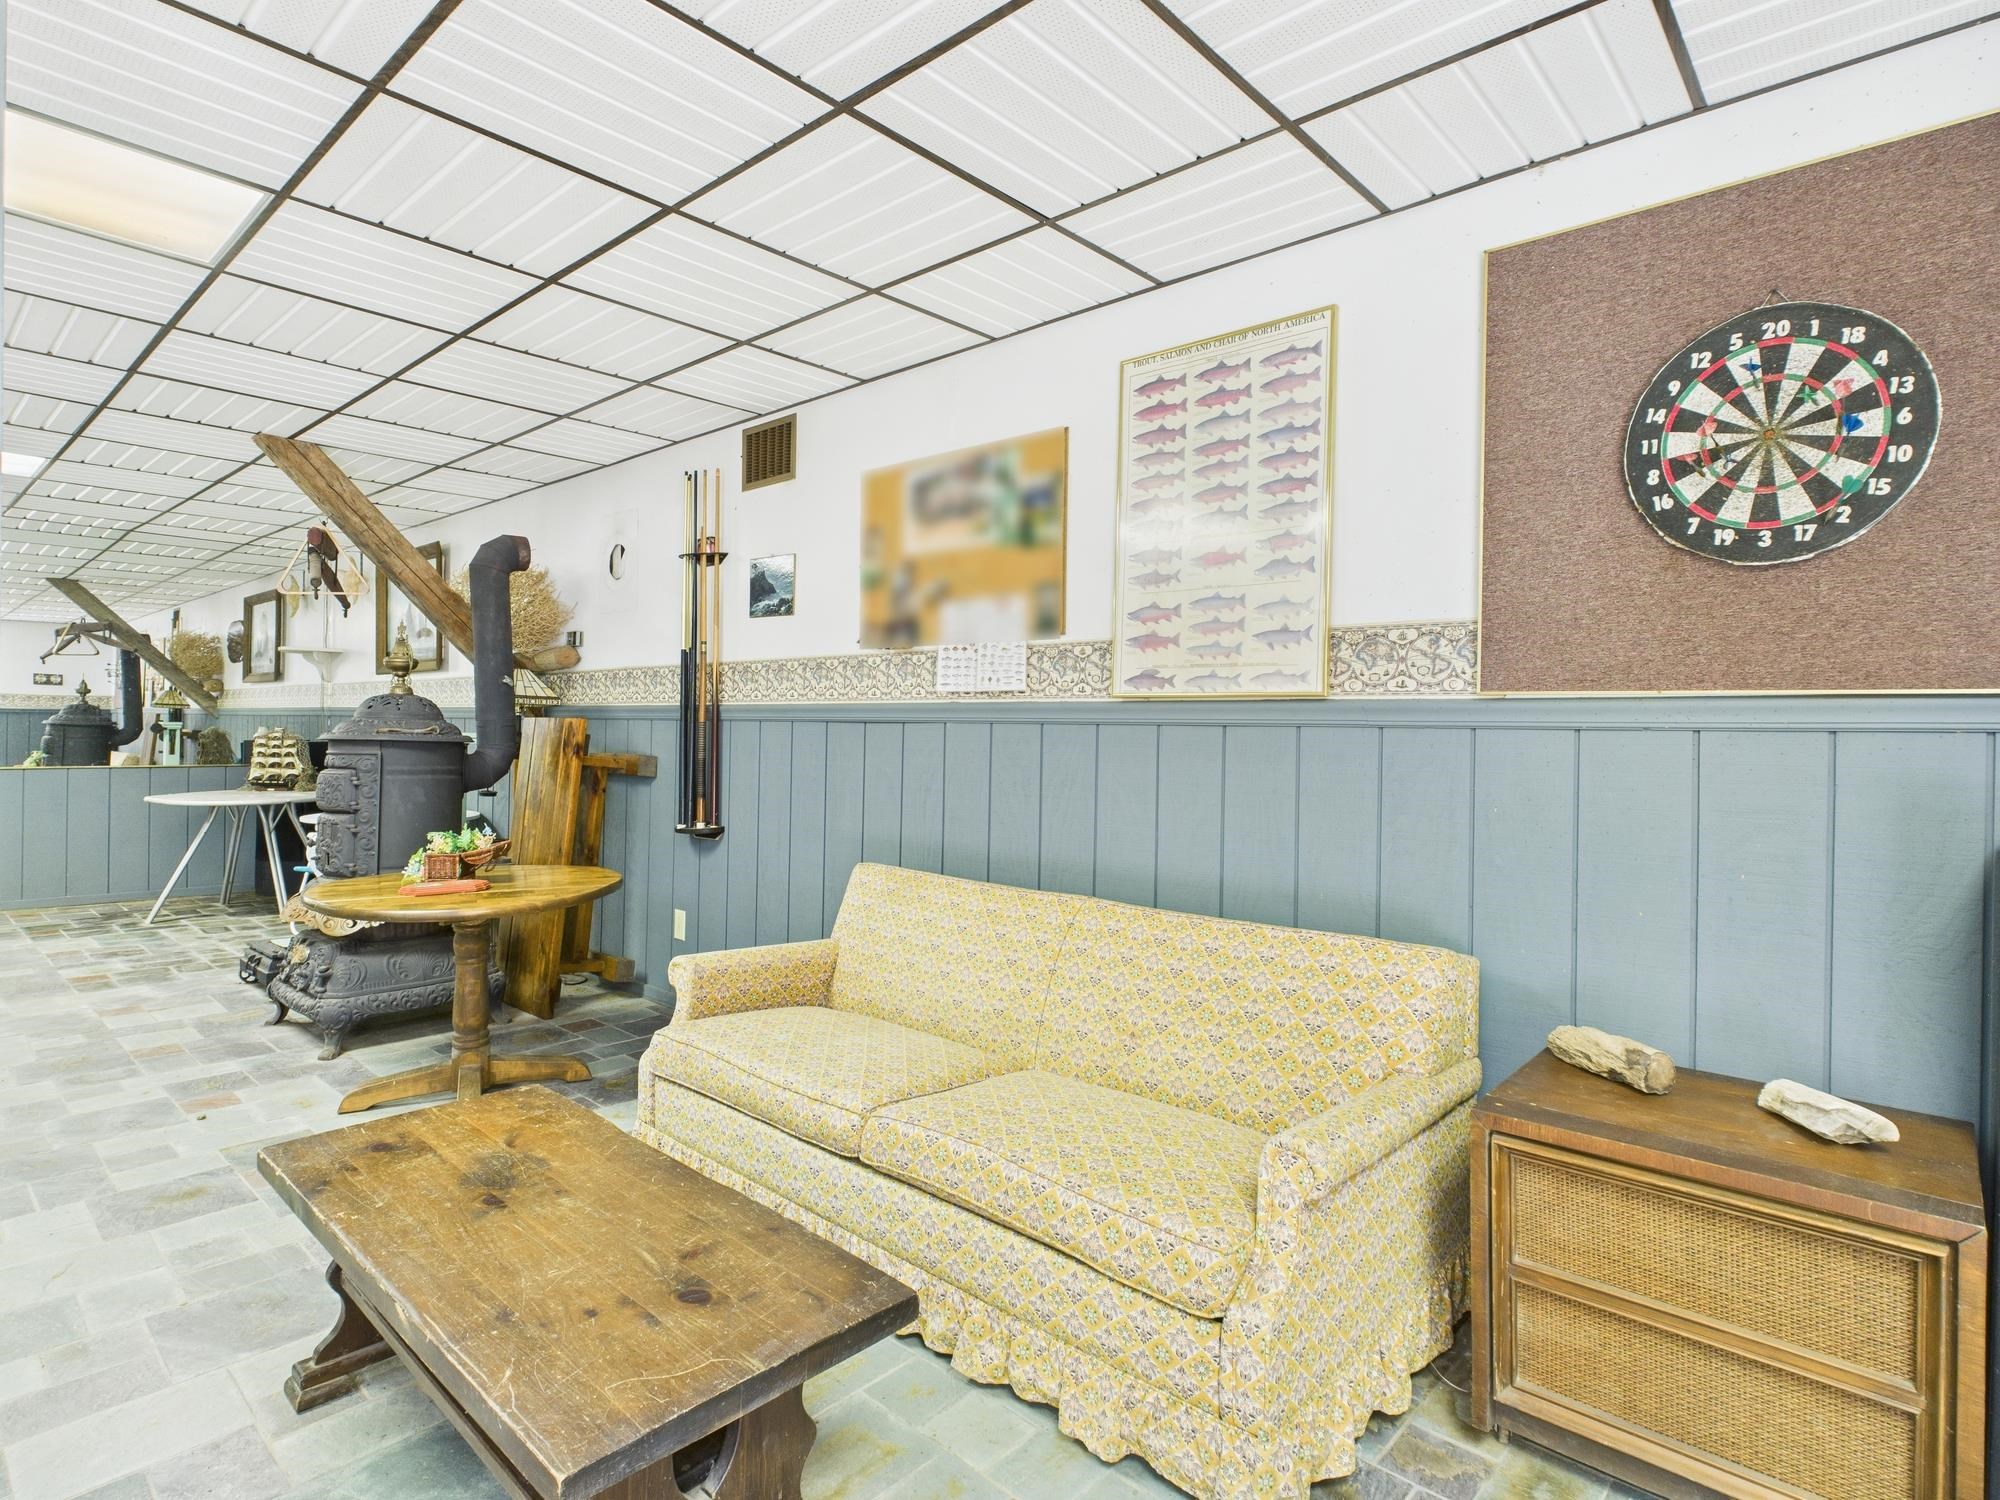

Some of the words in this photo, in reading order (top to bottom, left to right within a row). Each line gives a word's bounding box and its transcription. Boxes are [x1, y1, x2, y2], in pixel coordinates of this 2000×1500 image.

[1762, 320, 1791, 338] 20
[1810, 319, 1819, 335] 1
[1841, 326, 1866, 344] 18
[1160, 346, 1193, 361] SALMON
[1195, 343, 1212, 353] AND
[1213, 337, 1236, 348] CHAR
[1239, 332, 1250, 342] OF
[1252, 323, 1281, 337] NORTH
[1283, 312, 1326, 329] AMERICA
[1729, 333, 1743, 350] 5
[1691, 352, 1712, 369] 12
[1873, 349, 1888, 366] 4
[1668, 381, 1680, 396] 9
[1890, 376, 1914, 394] 13
[1646, 408, 1666, 424] 14
[1897, 407, 1912, 424] 6
[1641, 440, 1658, 454] 11
[1888, 445, 1912, 462] 10
[1647, 470, 1659, 485] 8
[1868, 478, 1891, 495] 15
[1652, 494, 1674, 511] 16
[1835, 506, 1851, 523] 2
[1687, 517, 1700, 534] 7
[1794, 524, 1817, 542] 17
[1714, 529, 1734, 546] 19
[1758, 530, 1772, 547] 3
